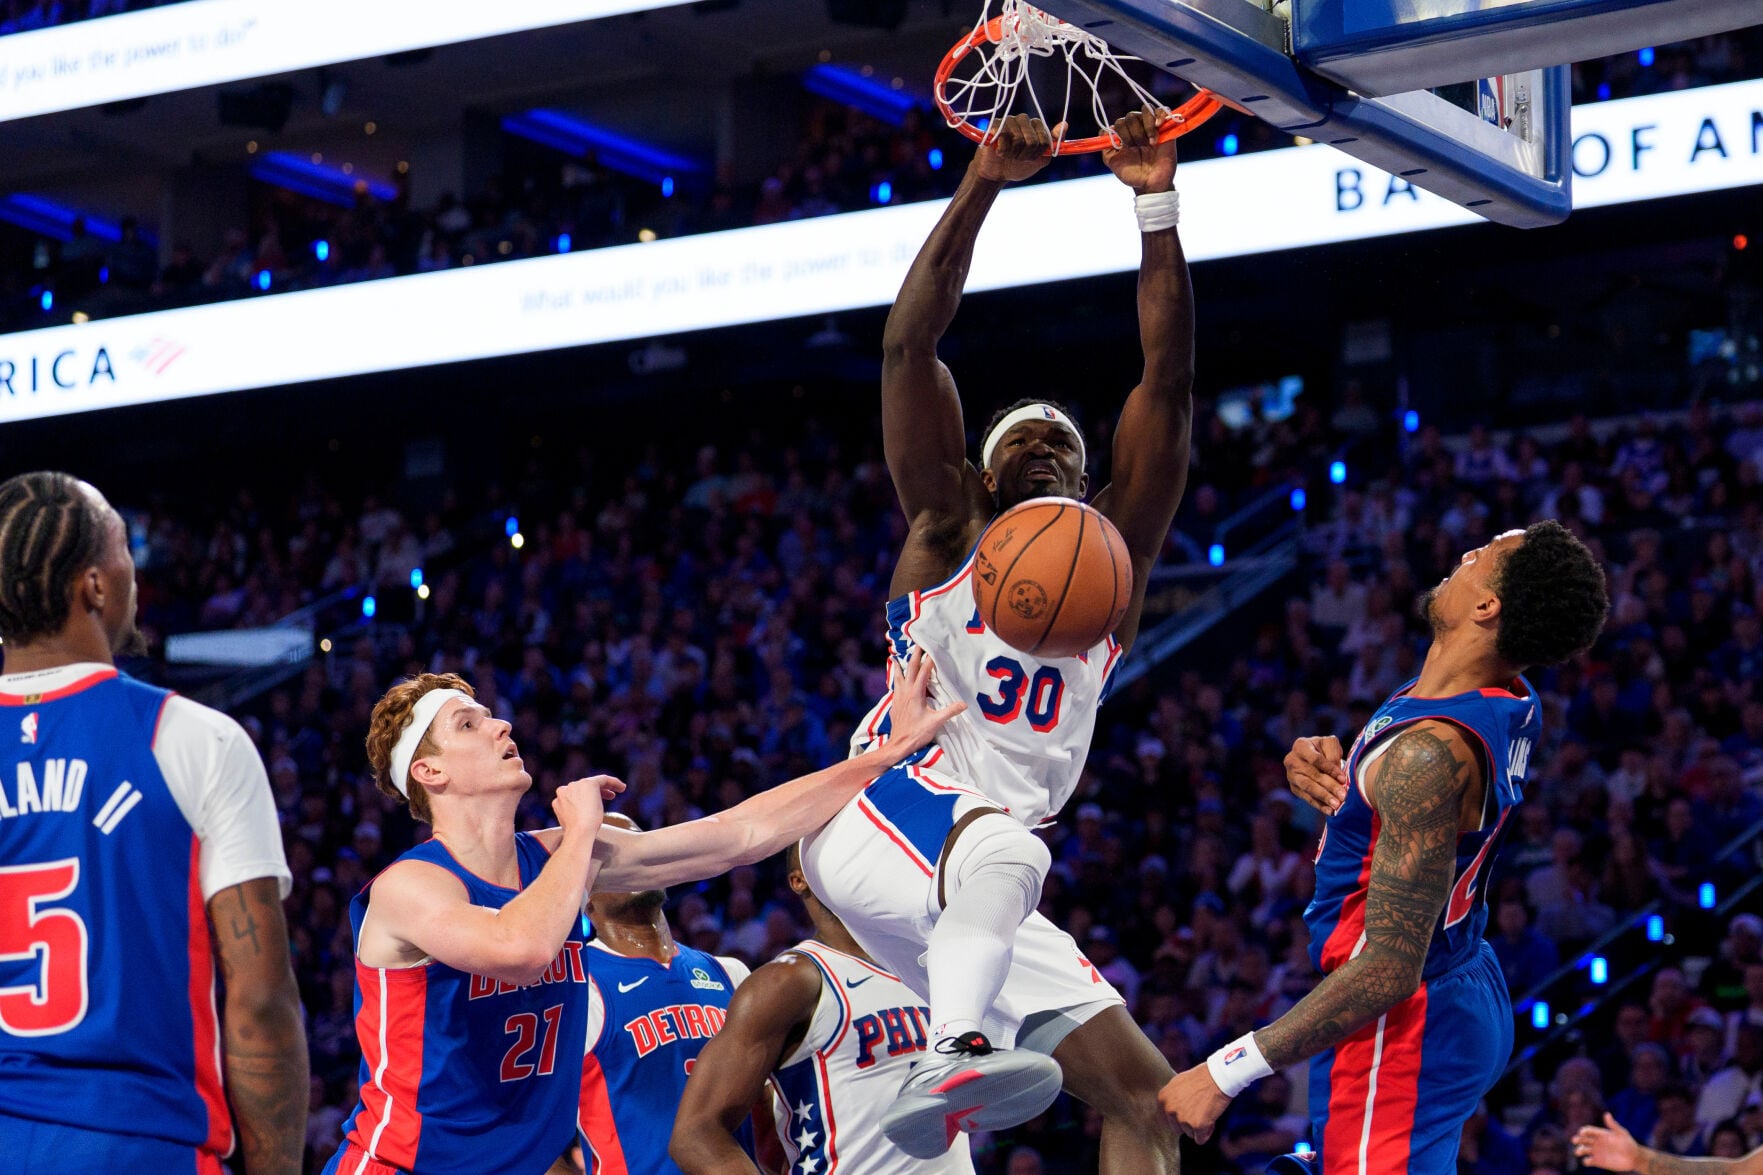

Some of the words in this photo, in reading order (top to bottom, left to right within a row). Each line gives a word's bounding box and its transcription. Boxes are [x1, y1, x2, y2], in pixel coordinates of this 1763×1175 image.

[1336, 168, 1418, 211] BA
[1571, 124, 1656, 178] OF
[976, 655, 1065, 733] 30
[0, 857, 88, 1038] 5
[500, 1003, 564, 1082] 21
[625, 1004, 728, 1058] DETRO
[852, 1006, 931, 1069] PHI
